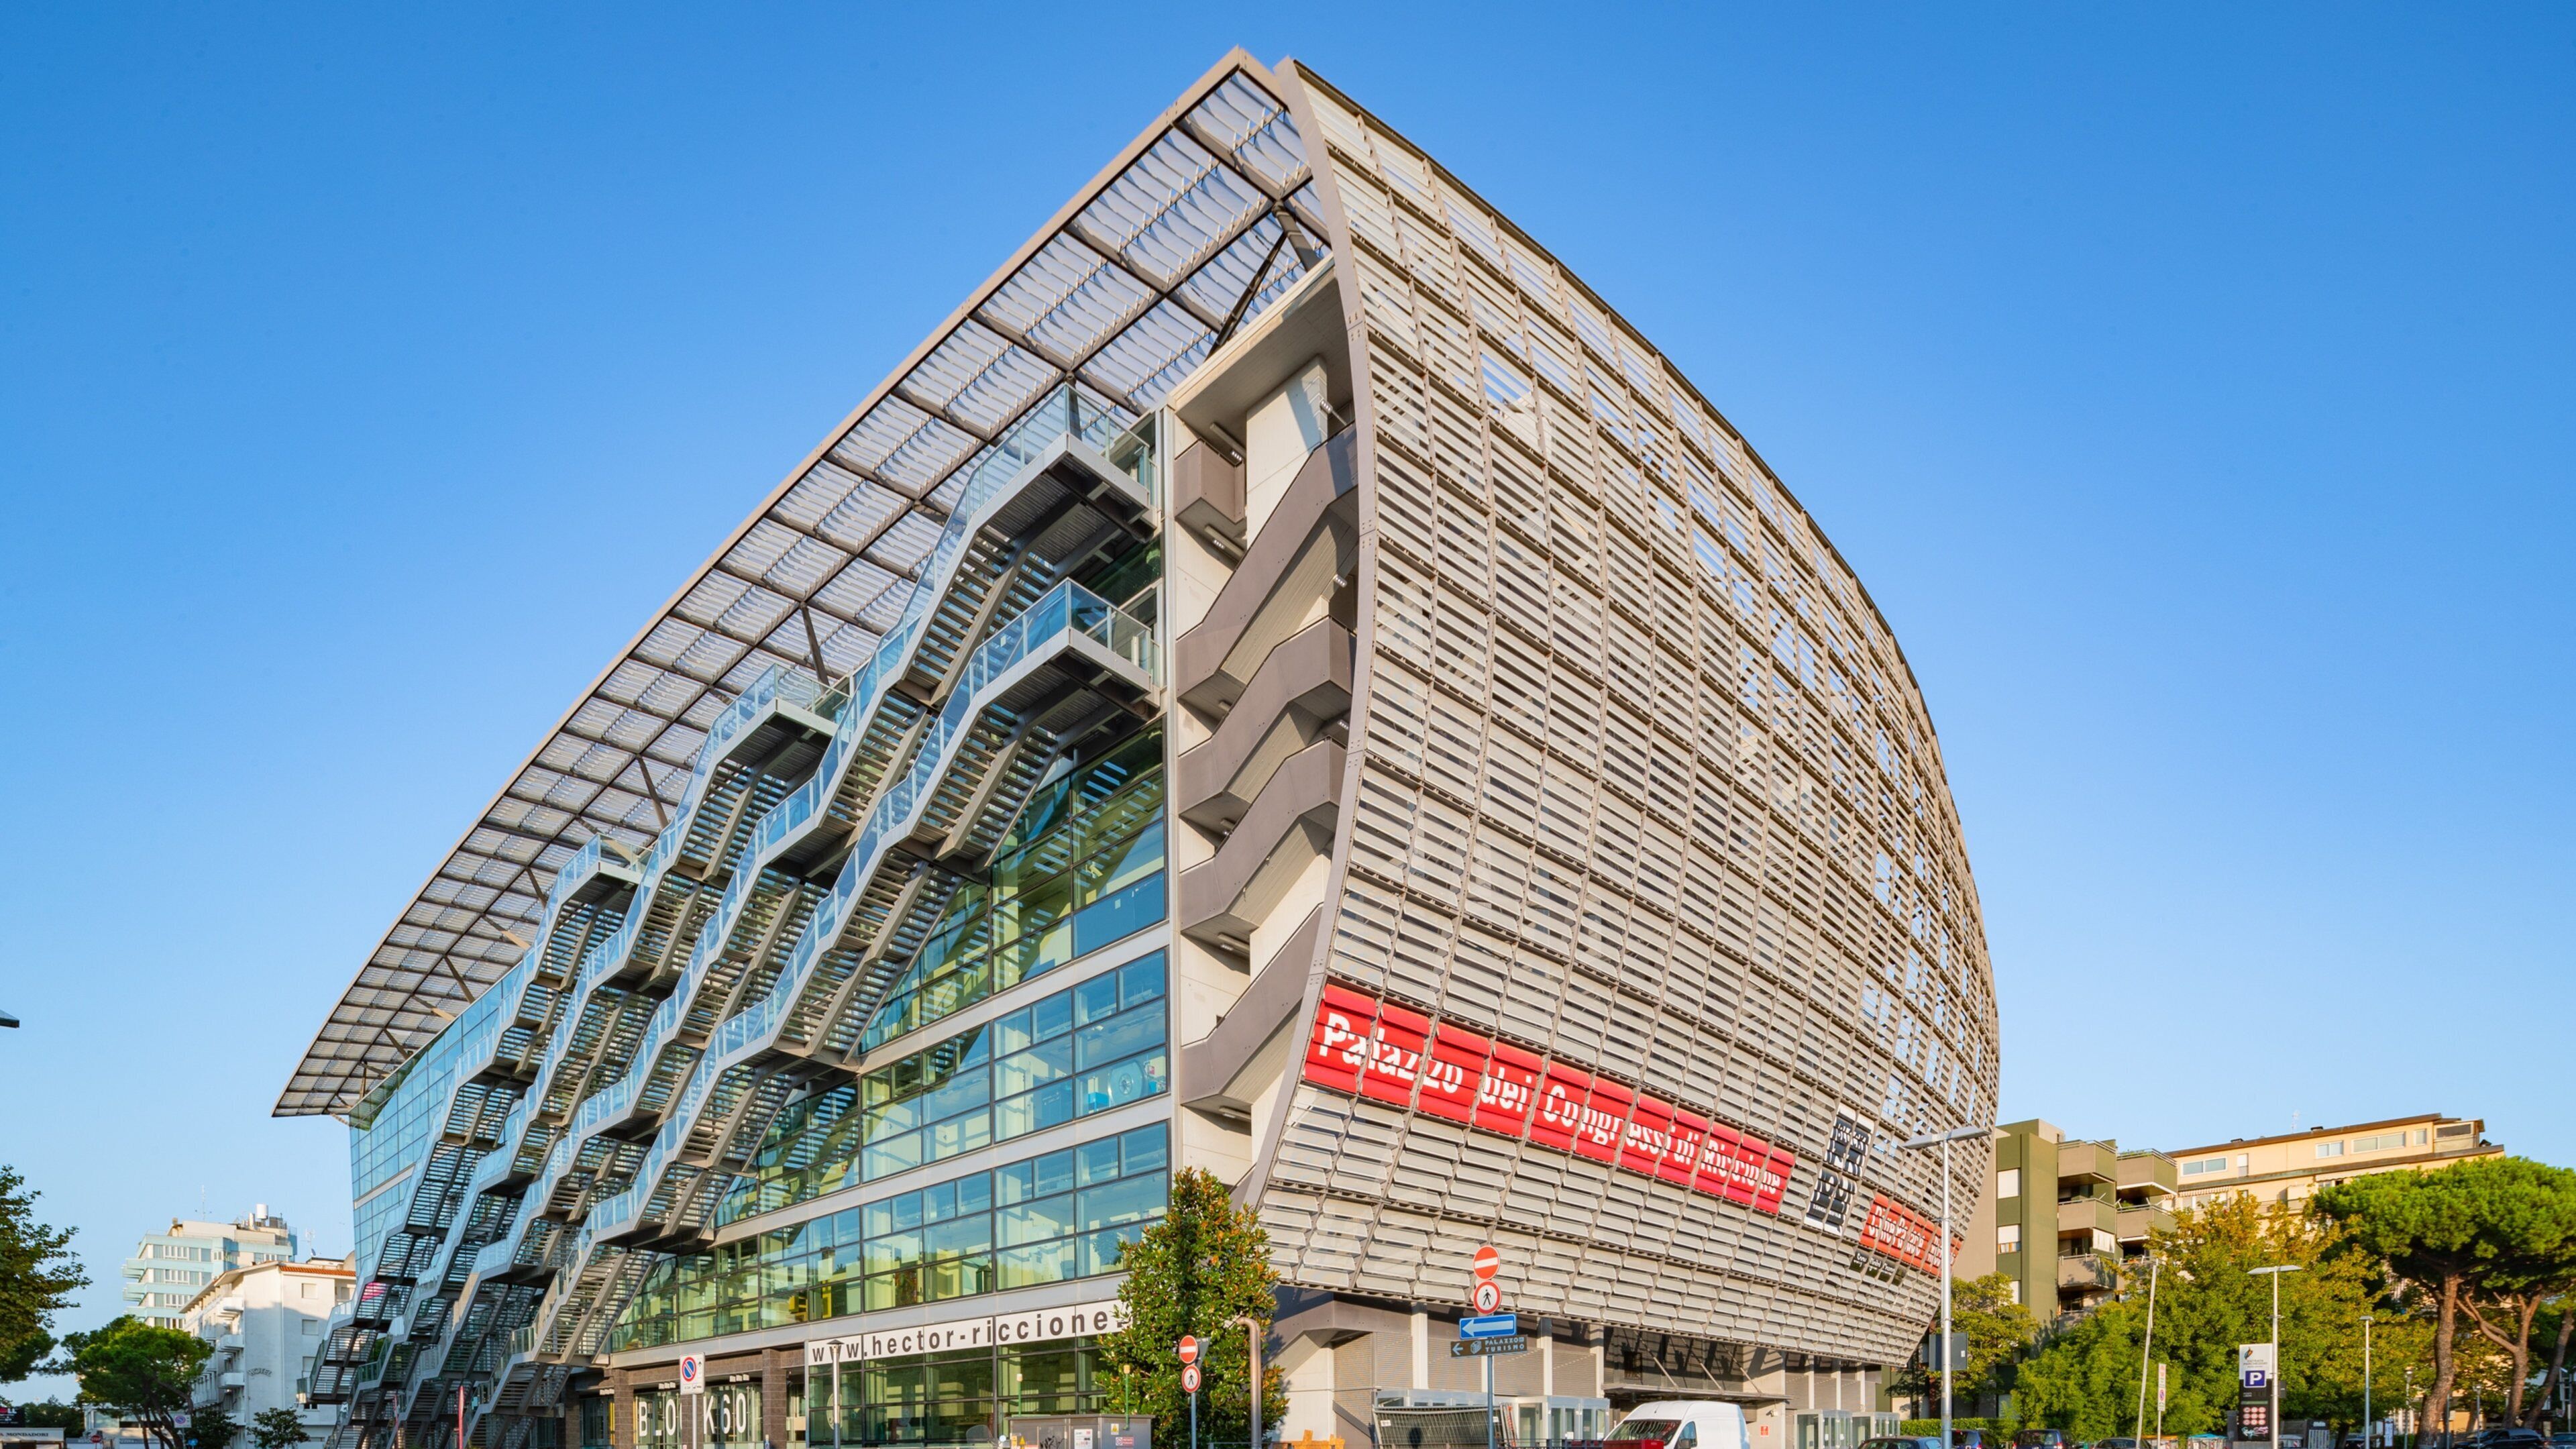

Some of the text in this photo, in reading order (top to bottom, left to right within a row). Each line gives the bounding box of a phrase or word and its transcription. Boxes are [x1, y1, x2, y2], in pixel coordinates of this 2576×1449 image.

[1319, 1012, 1781, 1195] Palazzo dei Congressi di Riccione
[1485, 1337, 1518, 1345] PALAZZO
[1485, 1344, 1524, 1352] TURISMO
[248, 1368, 272, 1377] HOTEL
[2249, 1372, 2262, 1385] P
